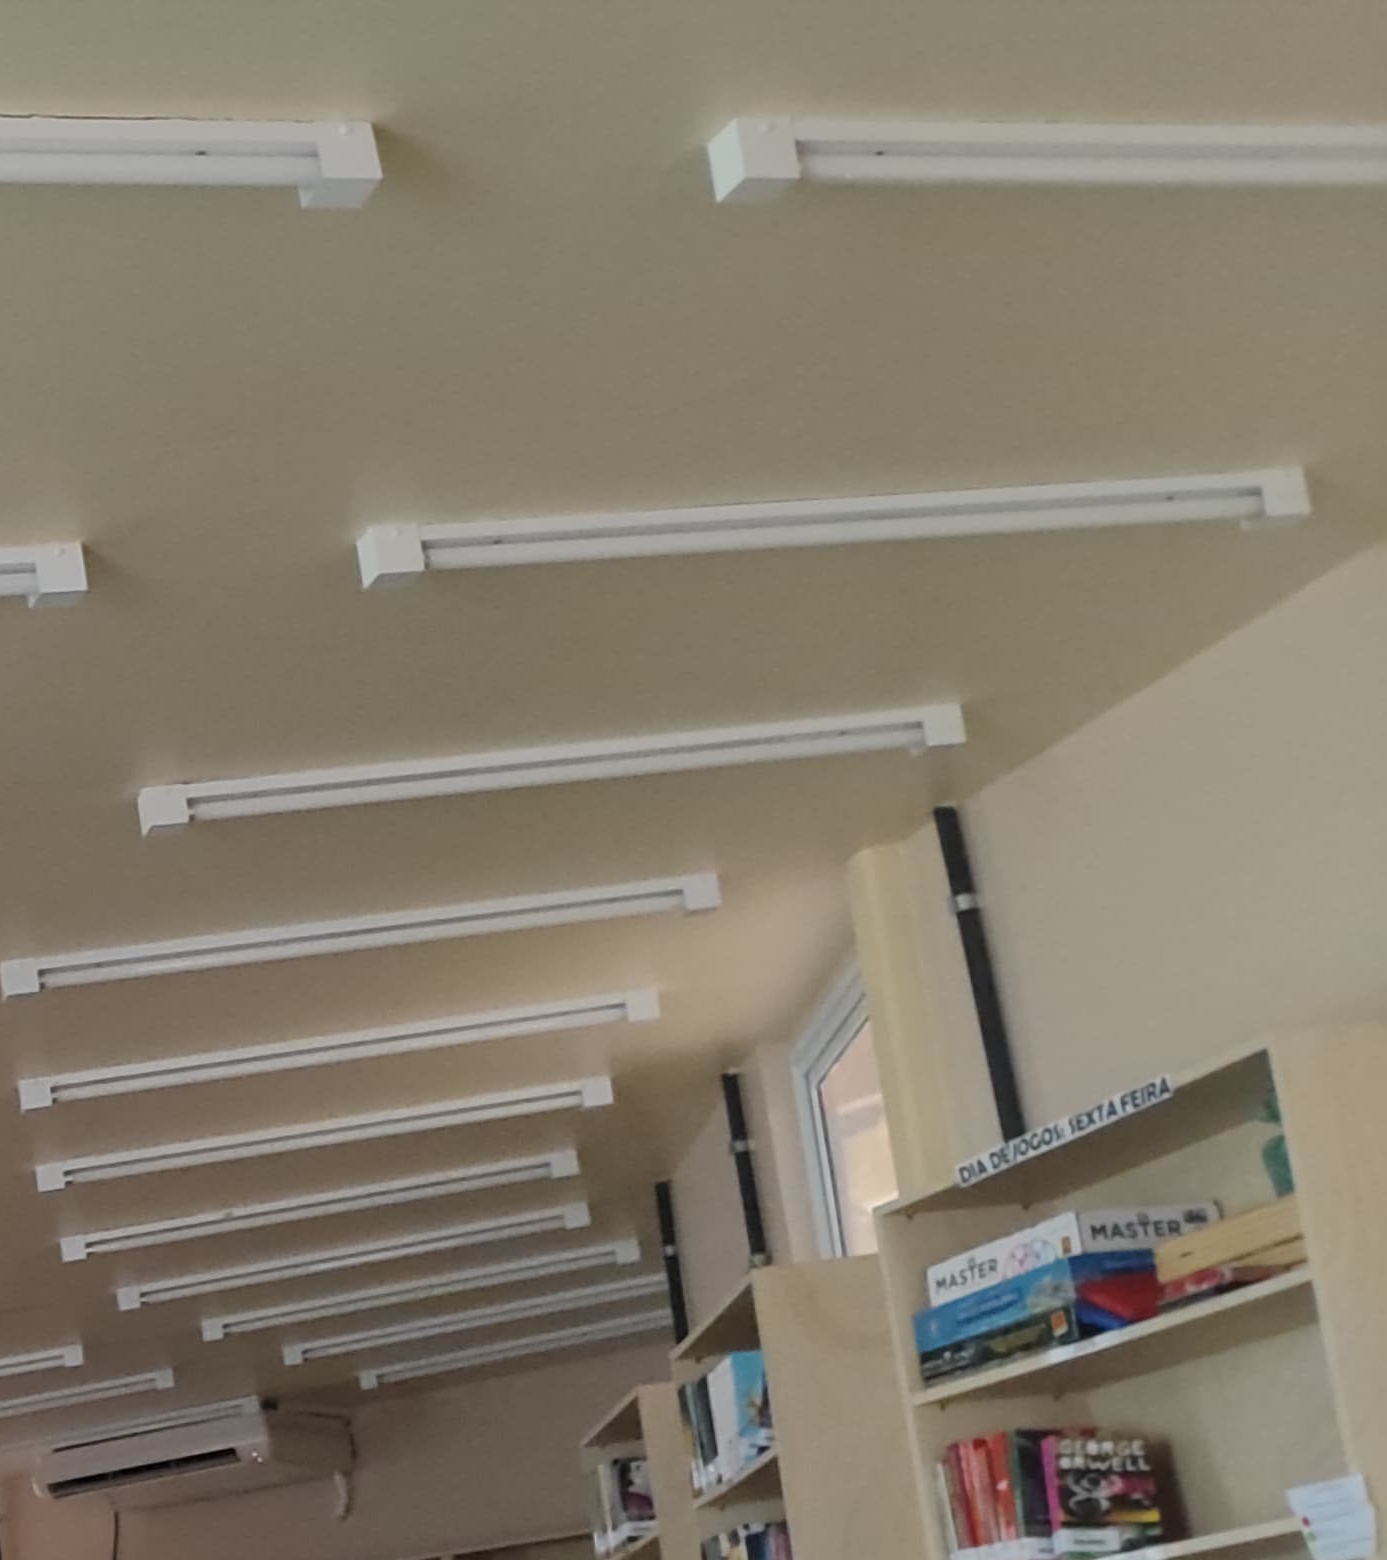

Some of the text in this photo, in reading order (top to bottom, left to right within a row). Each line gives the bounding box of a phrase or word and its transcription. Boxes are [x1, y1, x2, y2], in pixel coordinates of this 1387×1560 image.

[958, 1158, 988, 1185] DIA
[988, 1145, 1010, 1171] DE
[1067, 1099, 1118, 1135] SEXTA
[1119, 1075, 1172, 1113] FEIRA
[1090, 1215, 1183, 1241] MASTER
[936, 1258, 998, 1292] MASTER
[1058, 1438, 1145, 1456] GEORGE
[1058, 1455, 1151, 1472] ORWELL
